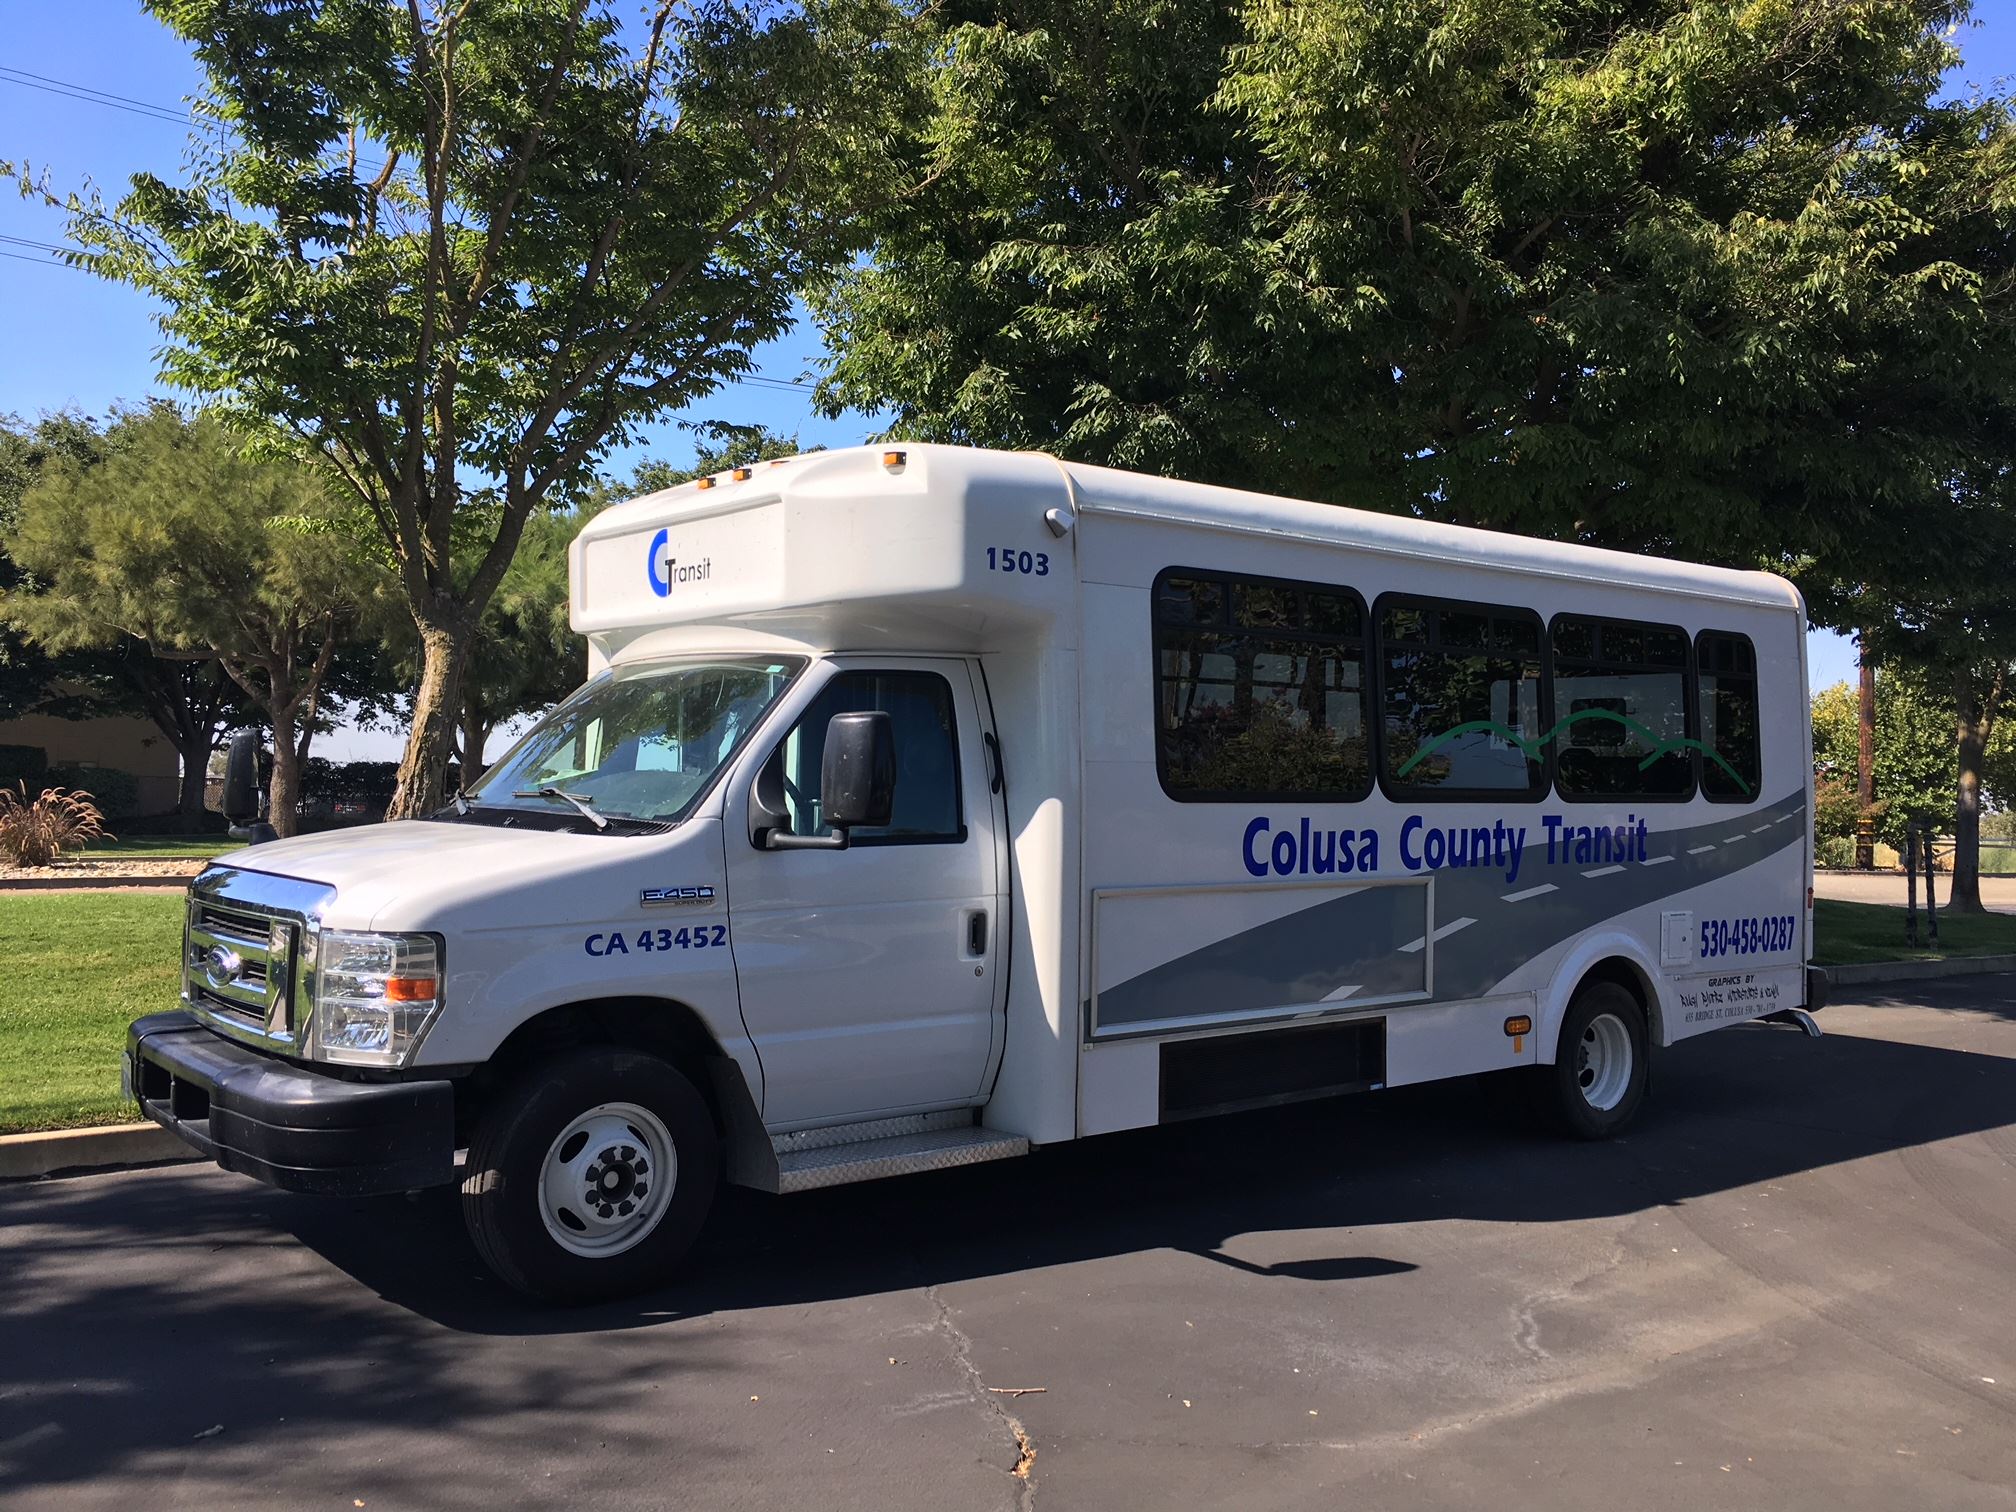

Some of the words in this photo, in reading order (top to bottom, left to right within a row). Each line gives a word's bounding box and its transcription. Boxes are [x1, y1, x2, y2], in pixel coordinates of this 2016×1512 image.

[665, 557, 711, 596] Transit
[986, 547, 1049, 576] 1503
[1242, 816, 1379, 877] Colusa
[1400, 815, 1527, 884] County
[1542, 814, 1648, 865] Transit
[584, 932, 629, 957] CA
[636, 925, 727, 952] 43452
[1700, 916, 1795, 958] 530-458-0287
[1708, 975, 1741, 987] GRAPHICS
[1745, 974, 1755, 984] BY
